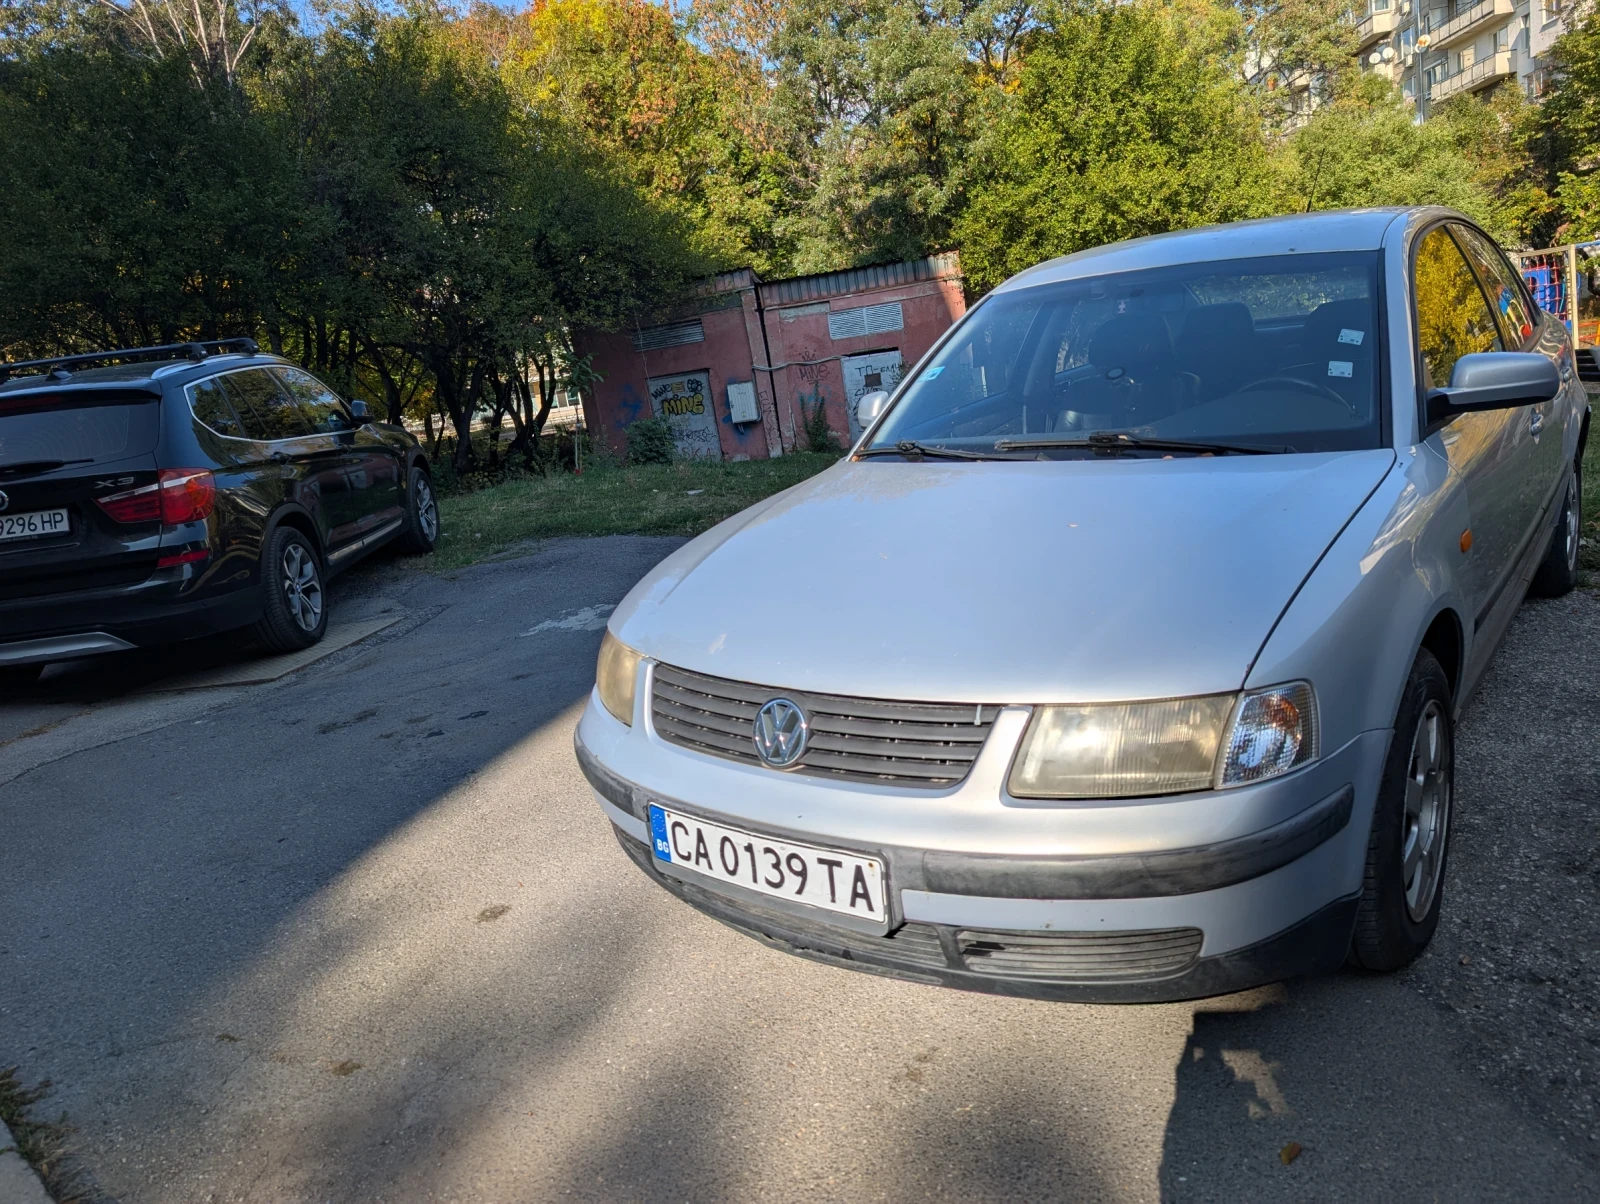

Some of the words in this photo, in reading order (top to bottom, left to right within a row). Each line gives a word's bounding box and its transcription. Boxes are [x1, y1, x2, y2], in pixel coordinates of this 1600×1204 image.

[94, 476, 134, 489] X3
[40, 512, 64, 531] HP
[656, 838, 669, 853] BG
[671, 820, 713, 871] CA
[719, 835, 808, 895] 0139
[817, 856, 875, 912] TA
